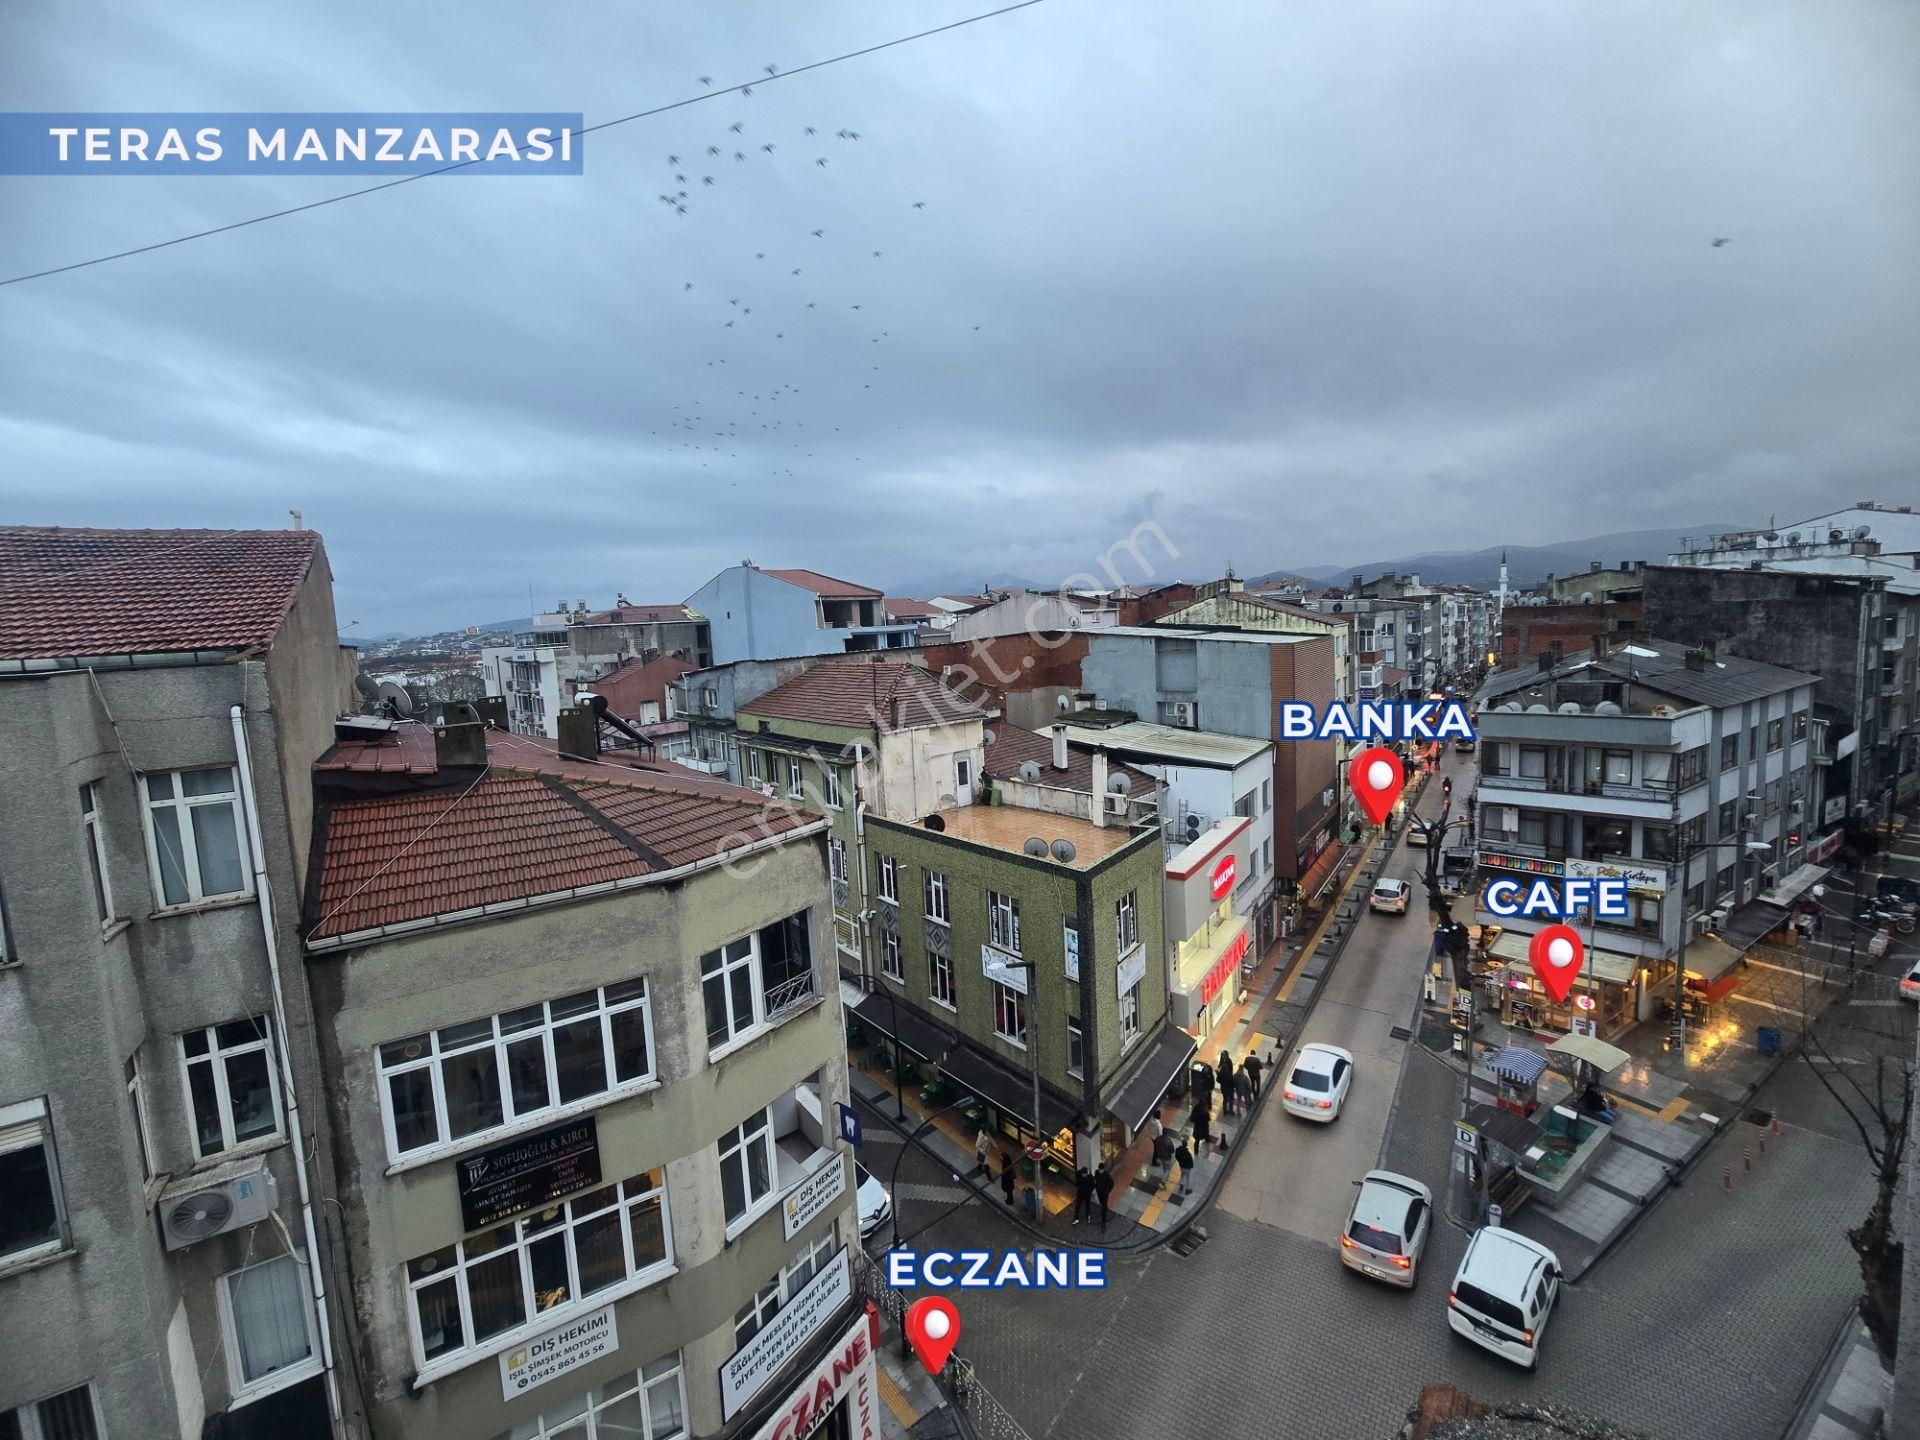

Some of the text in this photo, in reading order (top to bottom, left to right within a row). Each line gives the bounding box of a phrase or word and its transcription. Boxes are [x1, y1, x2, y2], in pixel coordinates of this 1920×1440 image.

[493, 1141, 548, 1169] SOFUOĞLU
[550, 1138, 558, 1149] &
[1461, 1129, 1472, 1142] D
[800, 1159, 841, 1201] DİŞ HEKİMİ
[531, 1312, 609, 1357] DİŞ HEKİMİ
[731, 1260, 842, 1379] SAĞLIK MESLEK HİZMET BİRİMİ
[734, 1278, 841, 1391] DİYETİSYEN ELİF NAZ DİLBAZ
[509, 1329, 609, 1381] IŞIL ŞİMŞEK MOTORCU
[530, 1343, 605, 1382] 0545 865 45 56
[766, 1350, 785, 1373] 0538
[785, 1335, 799, 1353] 643
[809, 1315, 818, 1328] 72
[764, 1329, 869, 1440] CZANE
